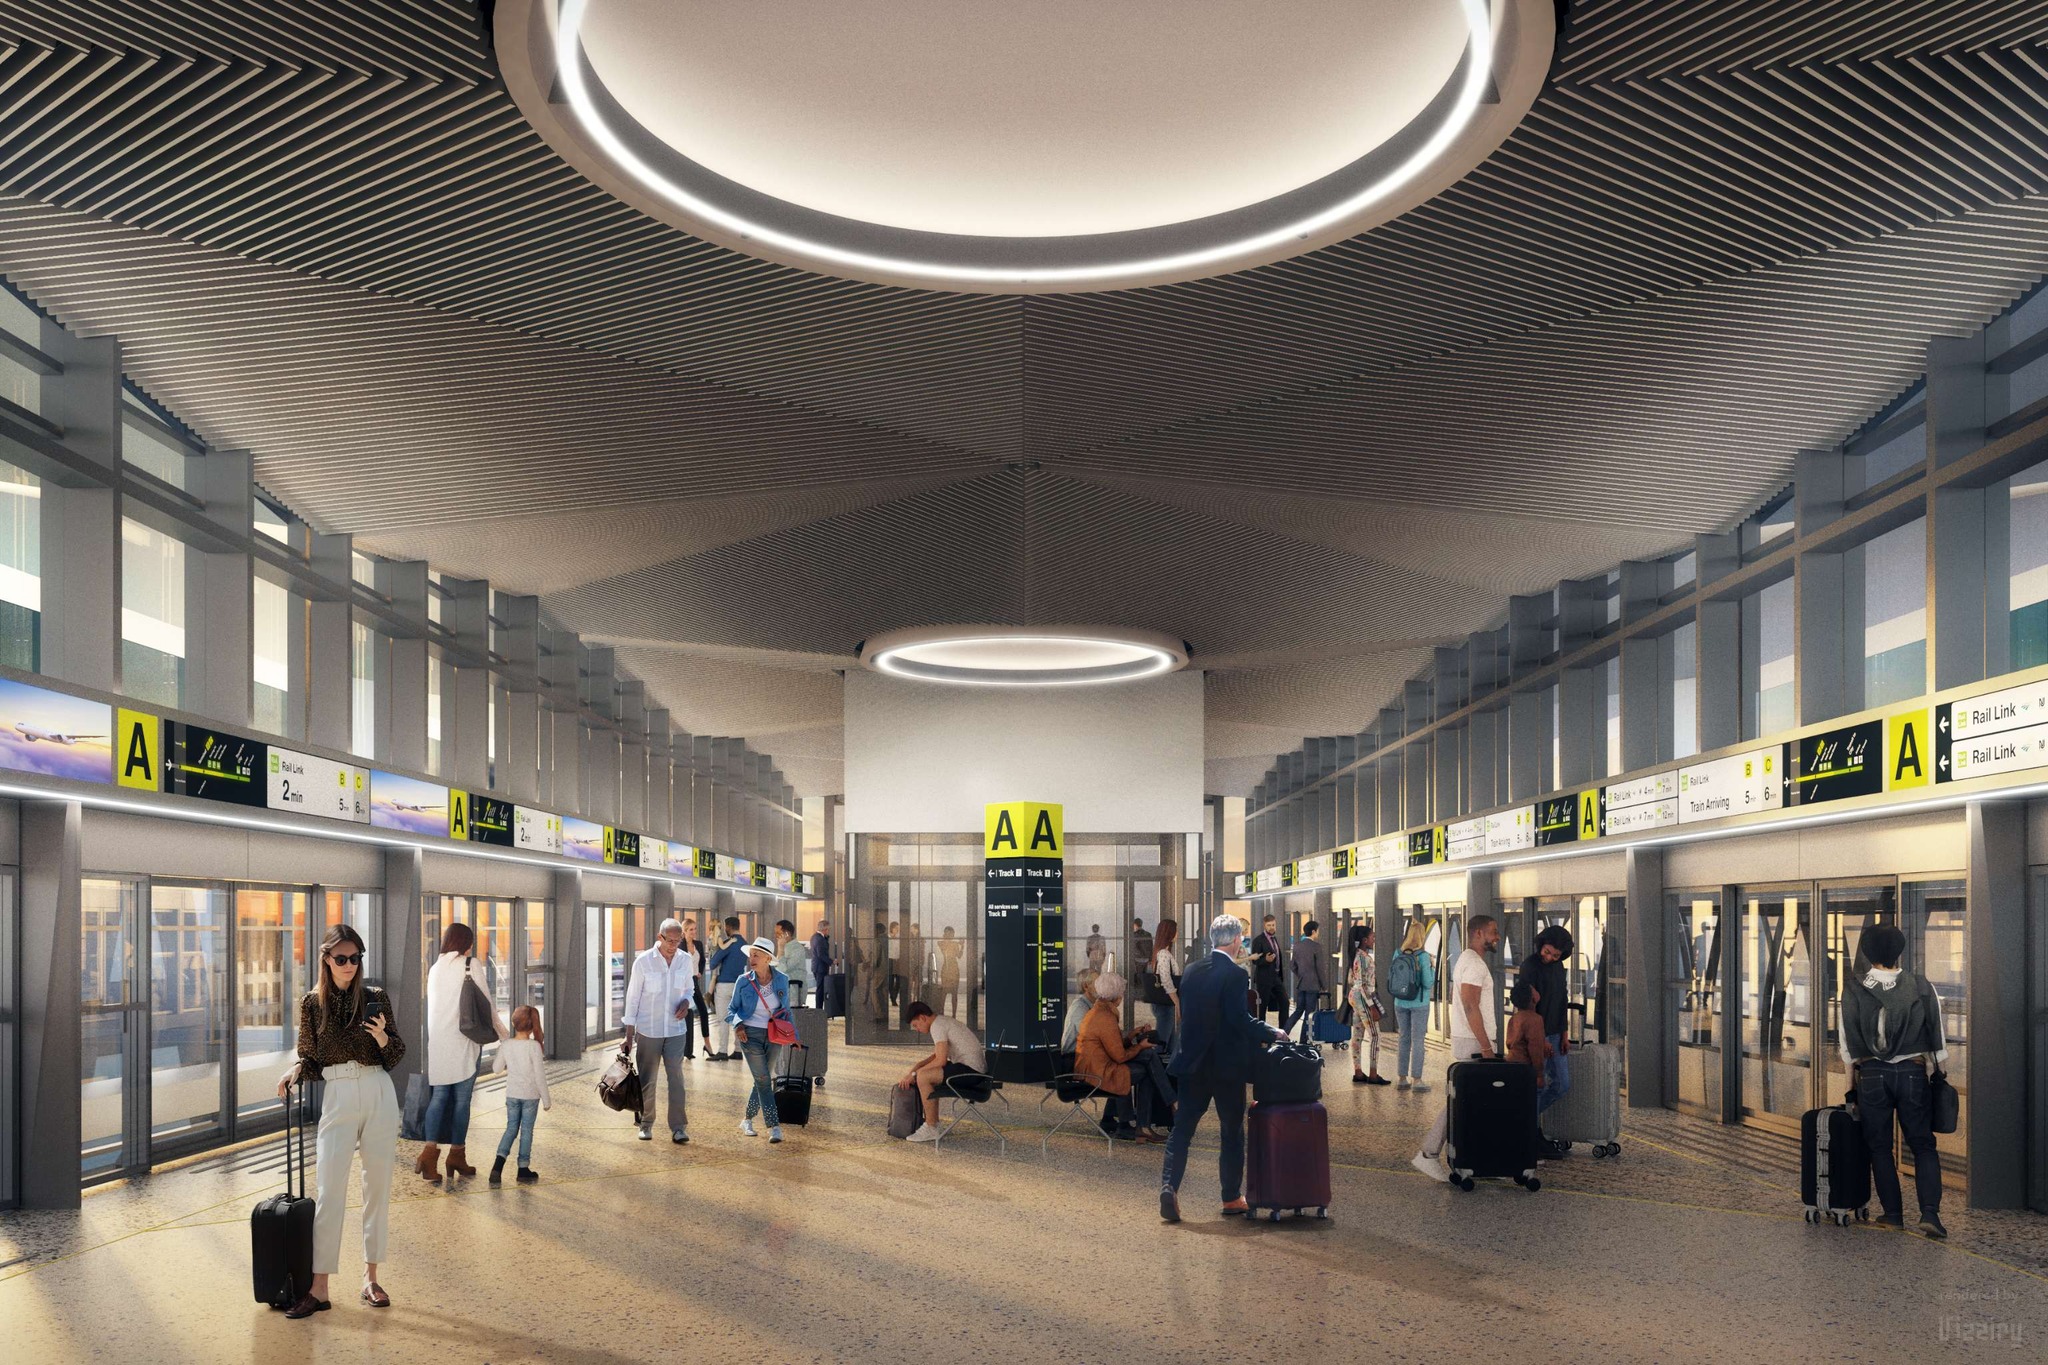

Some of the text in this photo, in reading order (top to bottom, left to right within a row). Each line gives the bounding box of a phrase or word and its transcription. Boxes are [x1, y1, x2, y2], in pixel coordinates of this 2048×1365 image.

[1973, 708, 1991, 725] Rail
[1994, 702, 2016, 721] Link
[125, 722, 152, 780] A
[1895, 722, 1922, 780] A
[1973, 749, 1991, 764] Rail
[1994, 743, 2016, 761] Link
[282, 761, 292, 773] Rail
[293, 763, 304, 775] Link
[1745, 763, 1751, 776] B
[1765, 758, 1771, 771] C
[339, 773, 345, 785] B
[356, 777, 361, 789] C
[1690, 776, 1699, 786] Rail
[1699, 775, 1709, 784] Link
[283, 780, 303, 803] 2 min
[1745, 790, 1750, 804] 5
[1764, 787, 1770, 801] 6
[339, 798, 344, 811] 5
[355, 801, 360, 814] 6
[1690, 796, 1729, 813] Train Arriving
[453, 796, 464, 834] A
[1583, 796, 1594, 834] A
[521, 827, 525, 842] 2
[992, 810, 1018, 850] A
[1030, 810, 1057, 850] A
[605, 831, 612, 859] A
[1435, 831, 1442, 858] A
[999, 869, 1015, 877] Track
